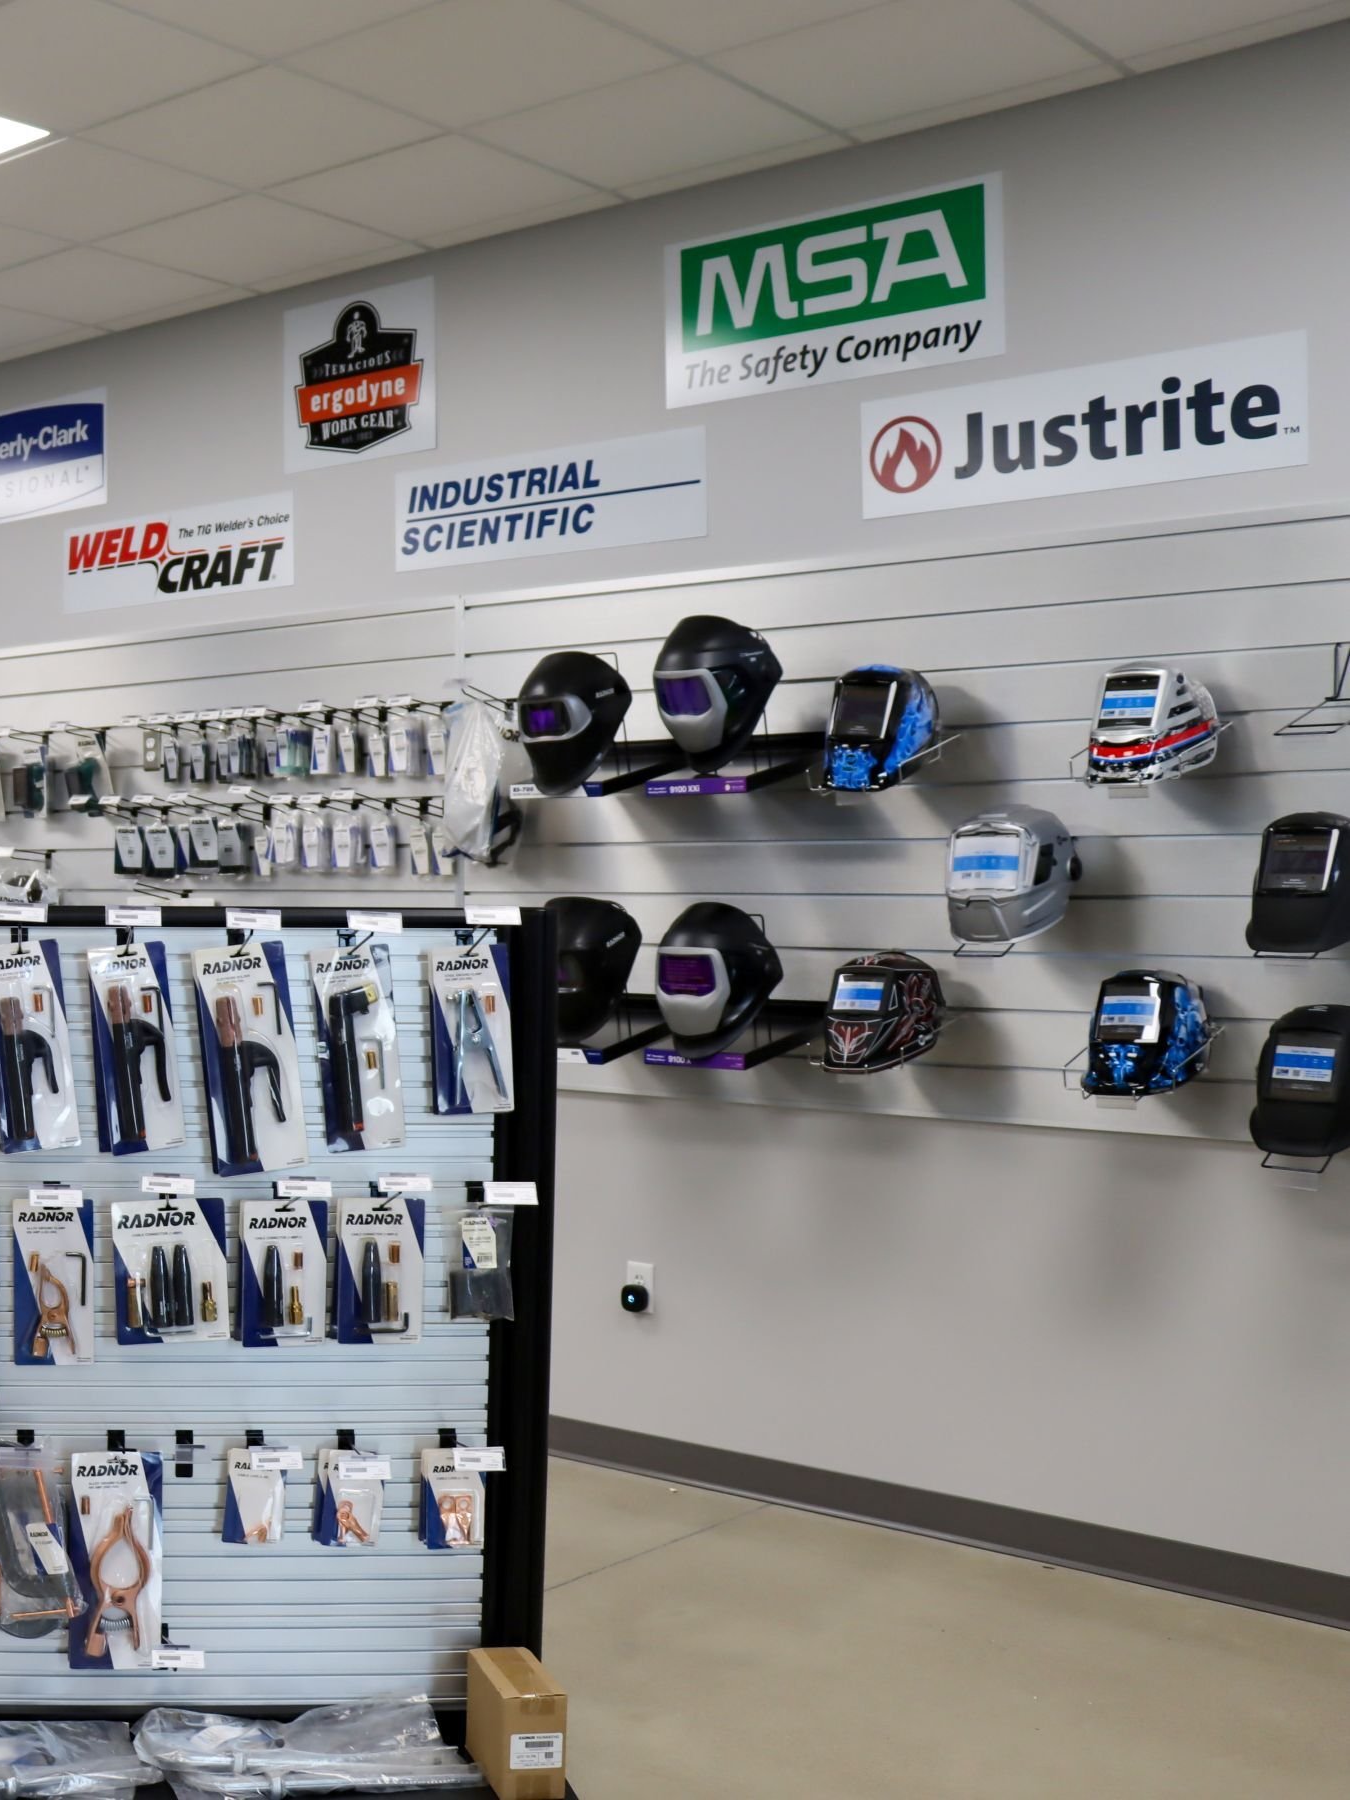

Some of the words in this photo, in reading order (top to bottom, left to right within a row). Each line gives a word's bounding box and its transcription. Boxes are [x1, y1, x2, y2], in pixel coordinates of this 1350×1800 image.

[696, 209, 969, 336] MSA
[324, 350, 391, 377] TENACIOUS
[684, 360, 731, 389] The
[739, 345, 828, 385] Safety
[836, 319, 982, 362] Company
[310, 377, 406, 413] ergodyne
[321, 416, 358, 441] WORK
[360, 410, 395, 429] GEAR
[954, 376, 1281, 480] Justrite
[408, 459, 600, 514] INDUSTRIAL
[178, 528, 194, 539] The
[197, 524, 212, 536] TIG
[215, 518, 254, 533] Welder's
[257, 512, 290, 527] Choice
[401, 503, 595, 555] SCIENTIFIC
[68, 521, 169, 571] WELD
[157, 542, 284, 593] CRAFT
[202, 957, 262, 976] RADNOR
[316, 958, 370, 973] RADNOR
[436, 958, 488, 972] RADNOR
[18, 1212, 74, 1223] RADNOR
[117, 1211, 195, 1229] RADNOR
[249, 1217, 307, 1229] RADNOR
[346, 1213, 403, 1225] RADNOR
[76, 1464, 139, 1477] RADNOR
